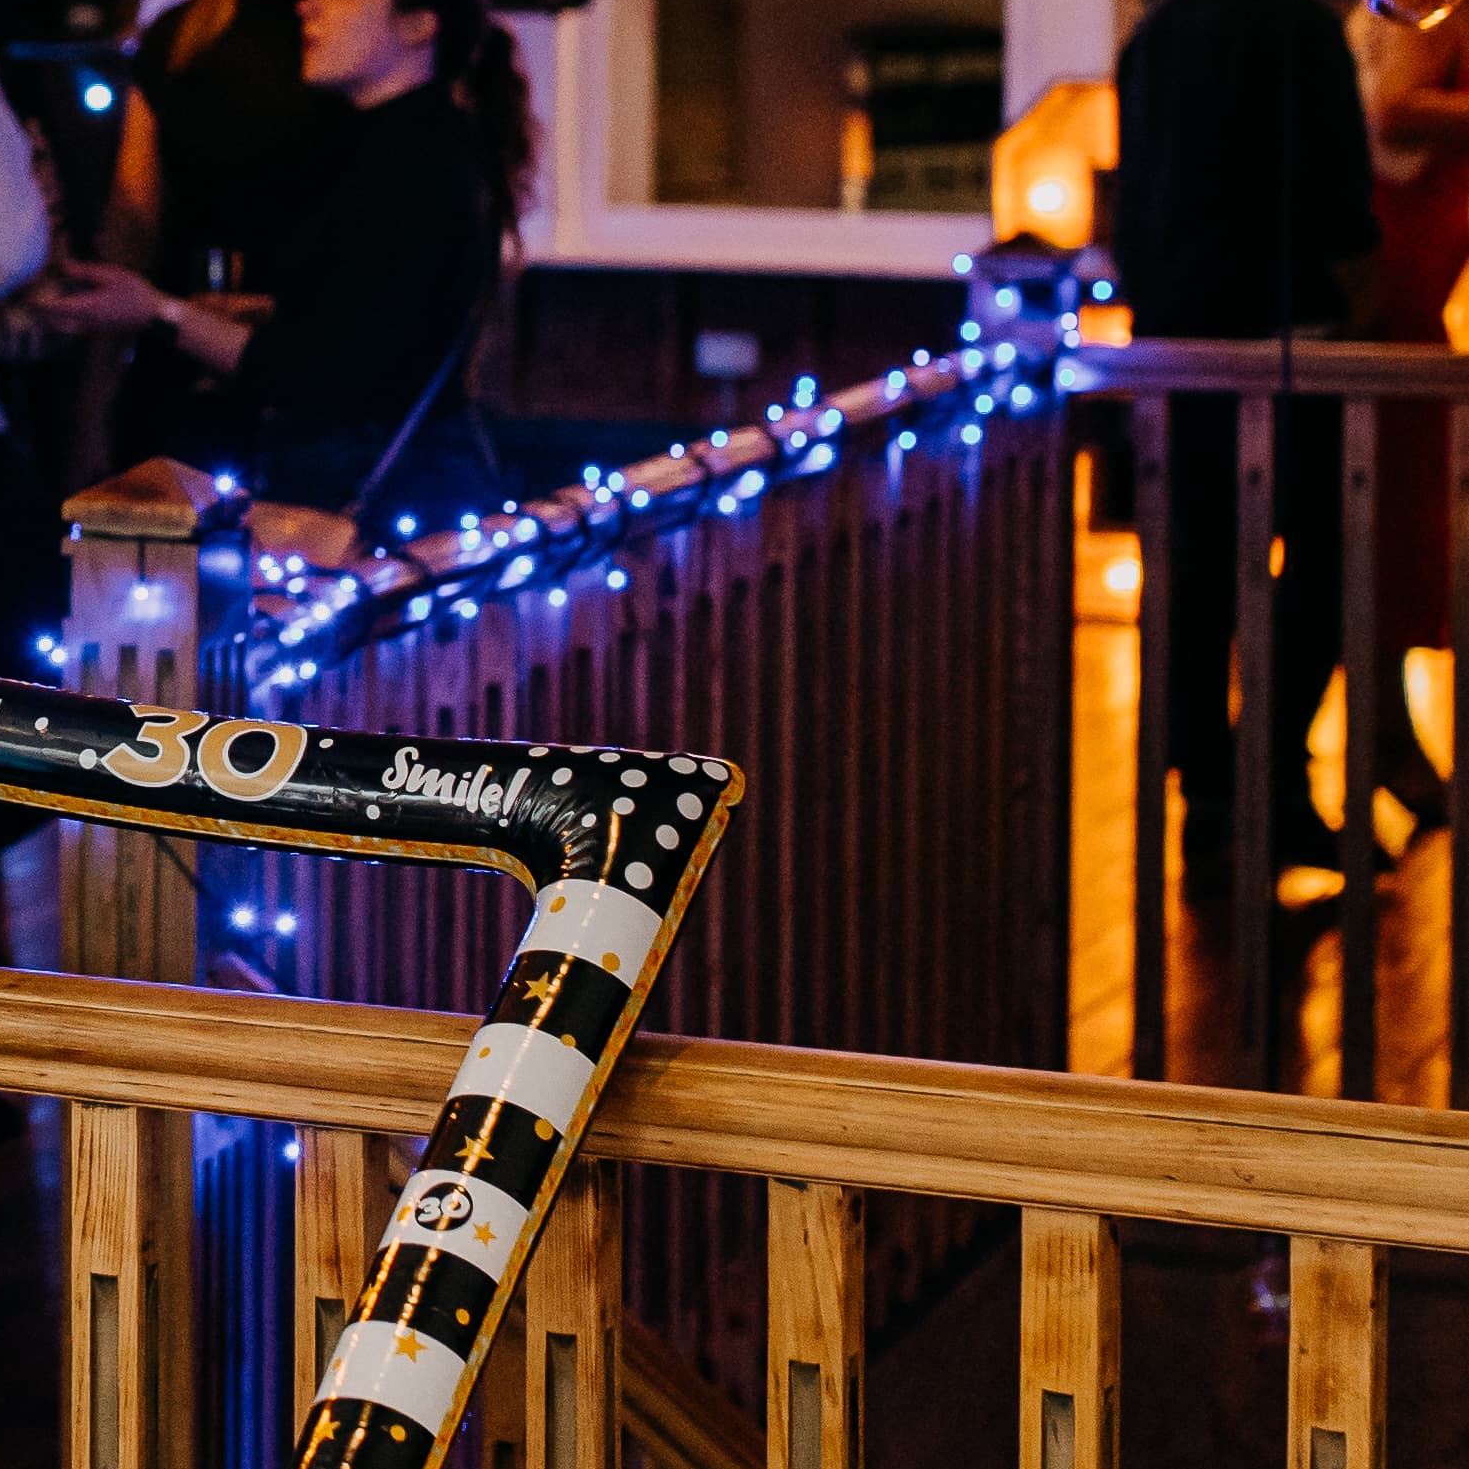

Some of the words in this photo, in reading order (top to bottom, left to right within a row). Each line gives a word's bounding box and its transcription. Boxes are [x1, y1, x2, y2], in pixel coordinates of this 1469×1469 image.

[101, 703, 308, 802] 30
[382, 745, 532, 828] Smile!
[418, 1189, 471, 1223] 30
